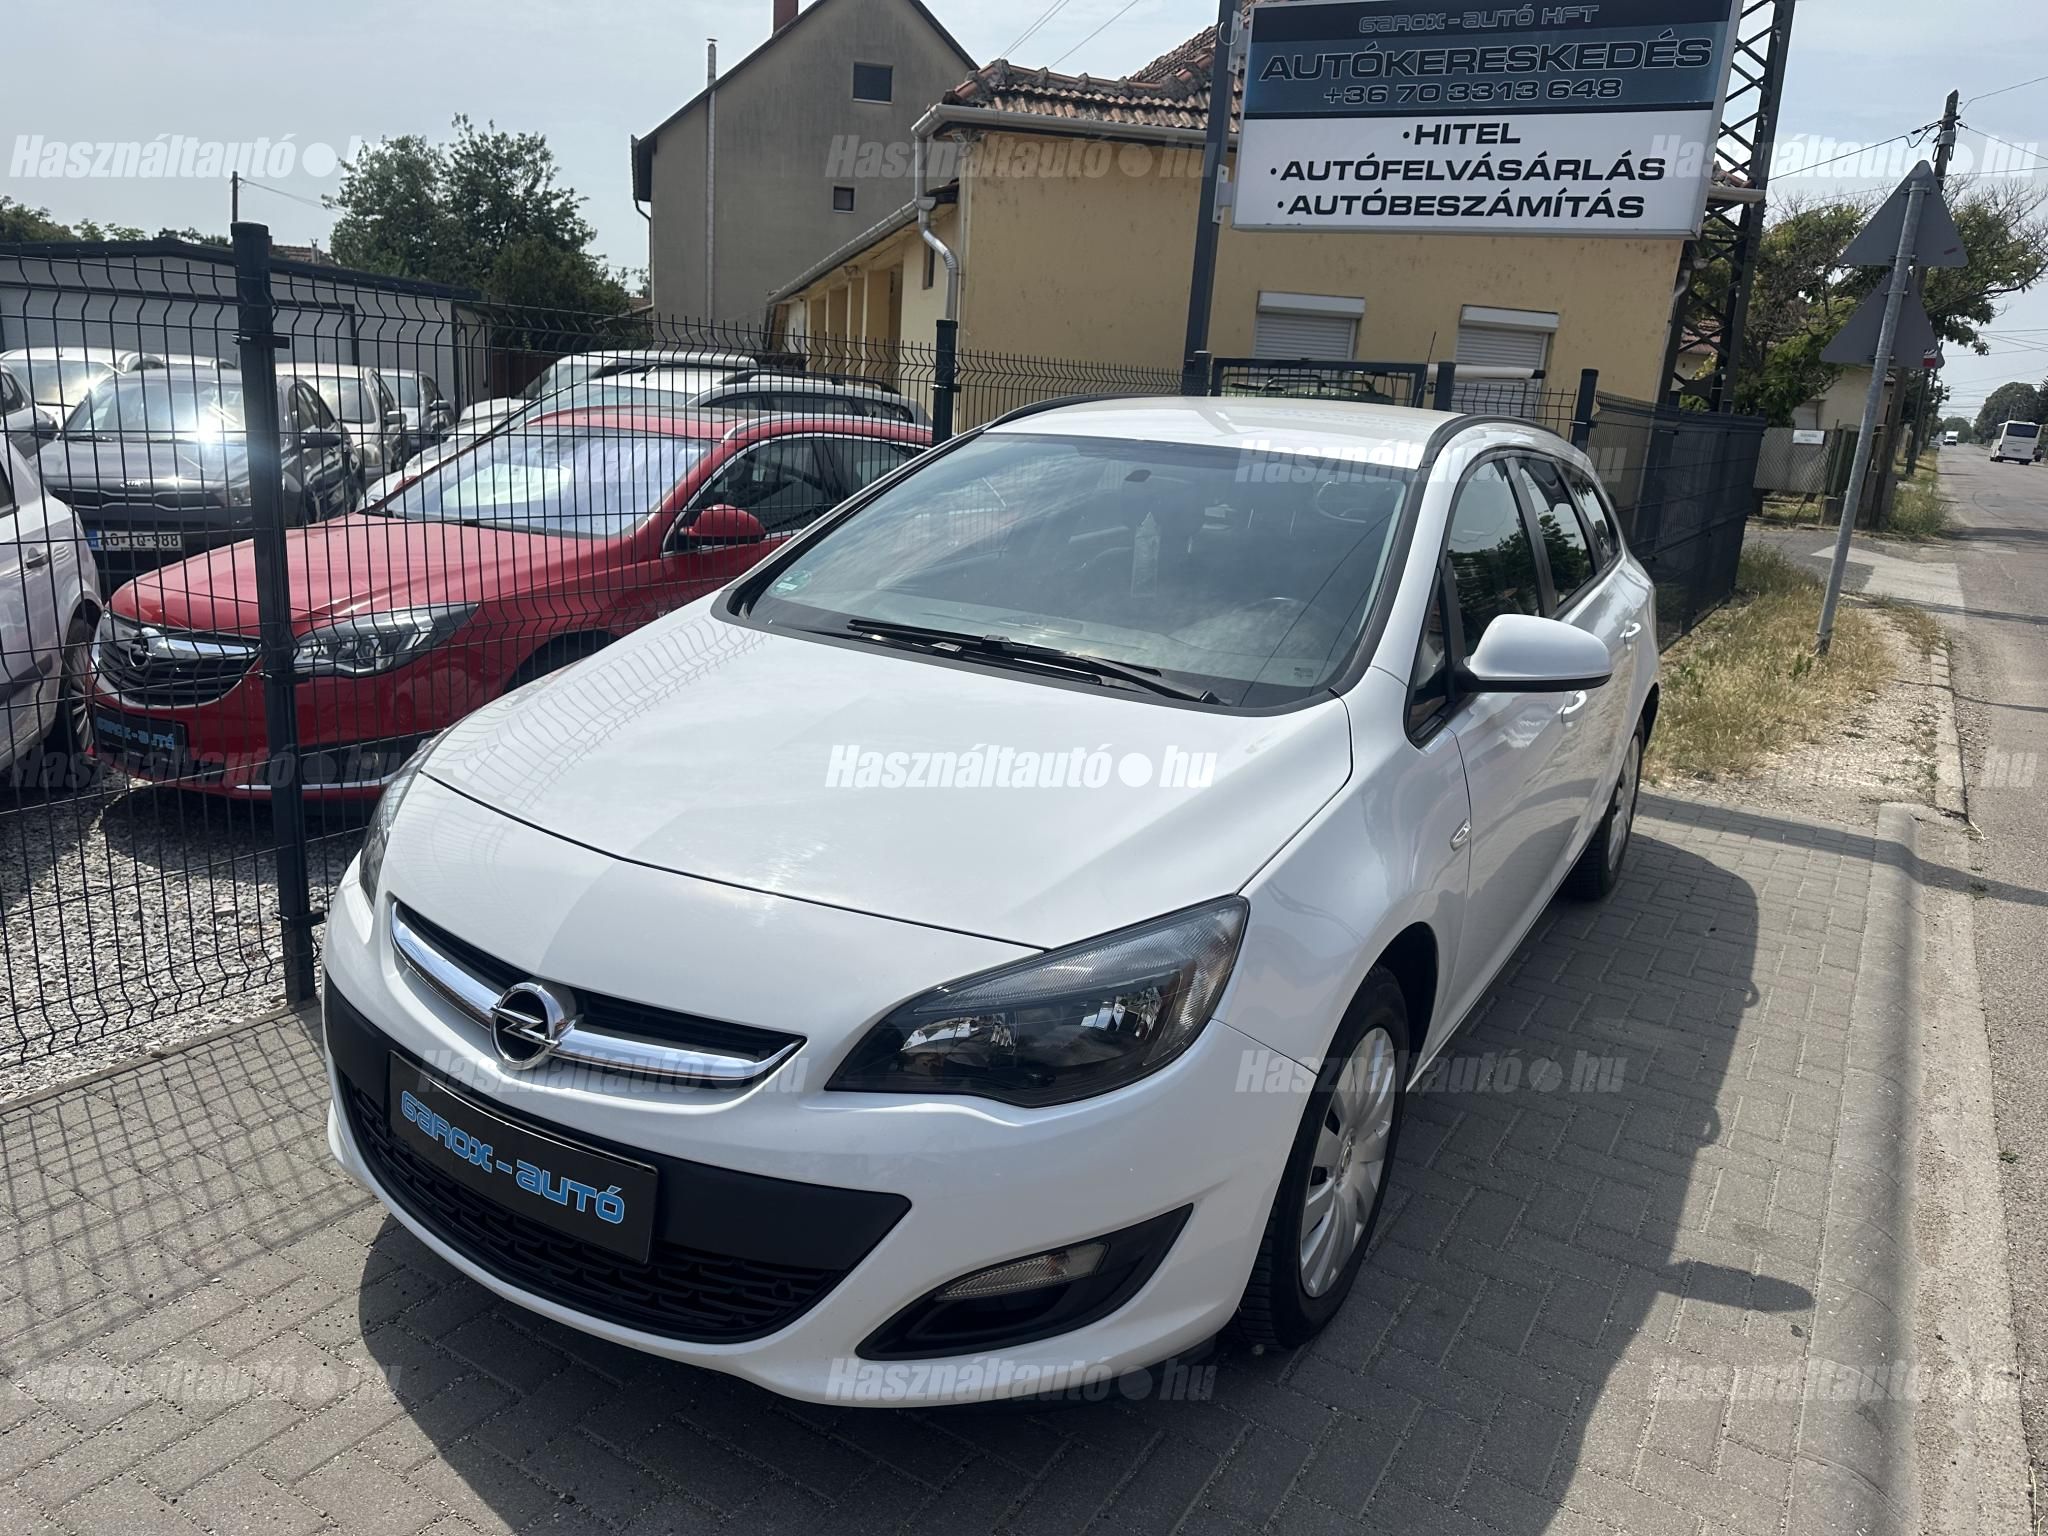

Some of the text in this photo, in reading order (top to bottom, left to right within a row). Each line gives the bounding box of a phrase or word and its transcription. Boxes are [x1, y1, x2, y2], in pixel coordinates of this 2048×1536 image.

[1259, 28, 1712, 81] AUTÓKERESKEDÉS
[1324, 78, 1623, 104] +36 70 3313 648
